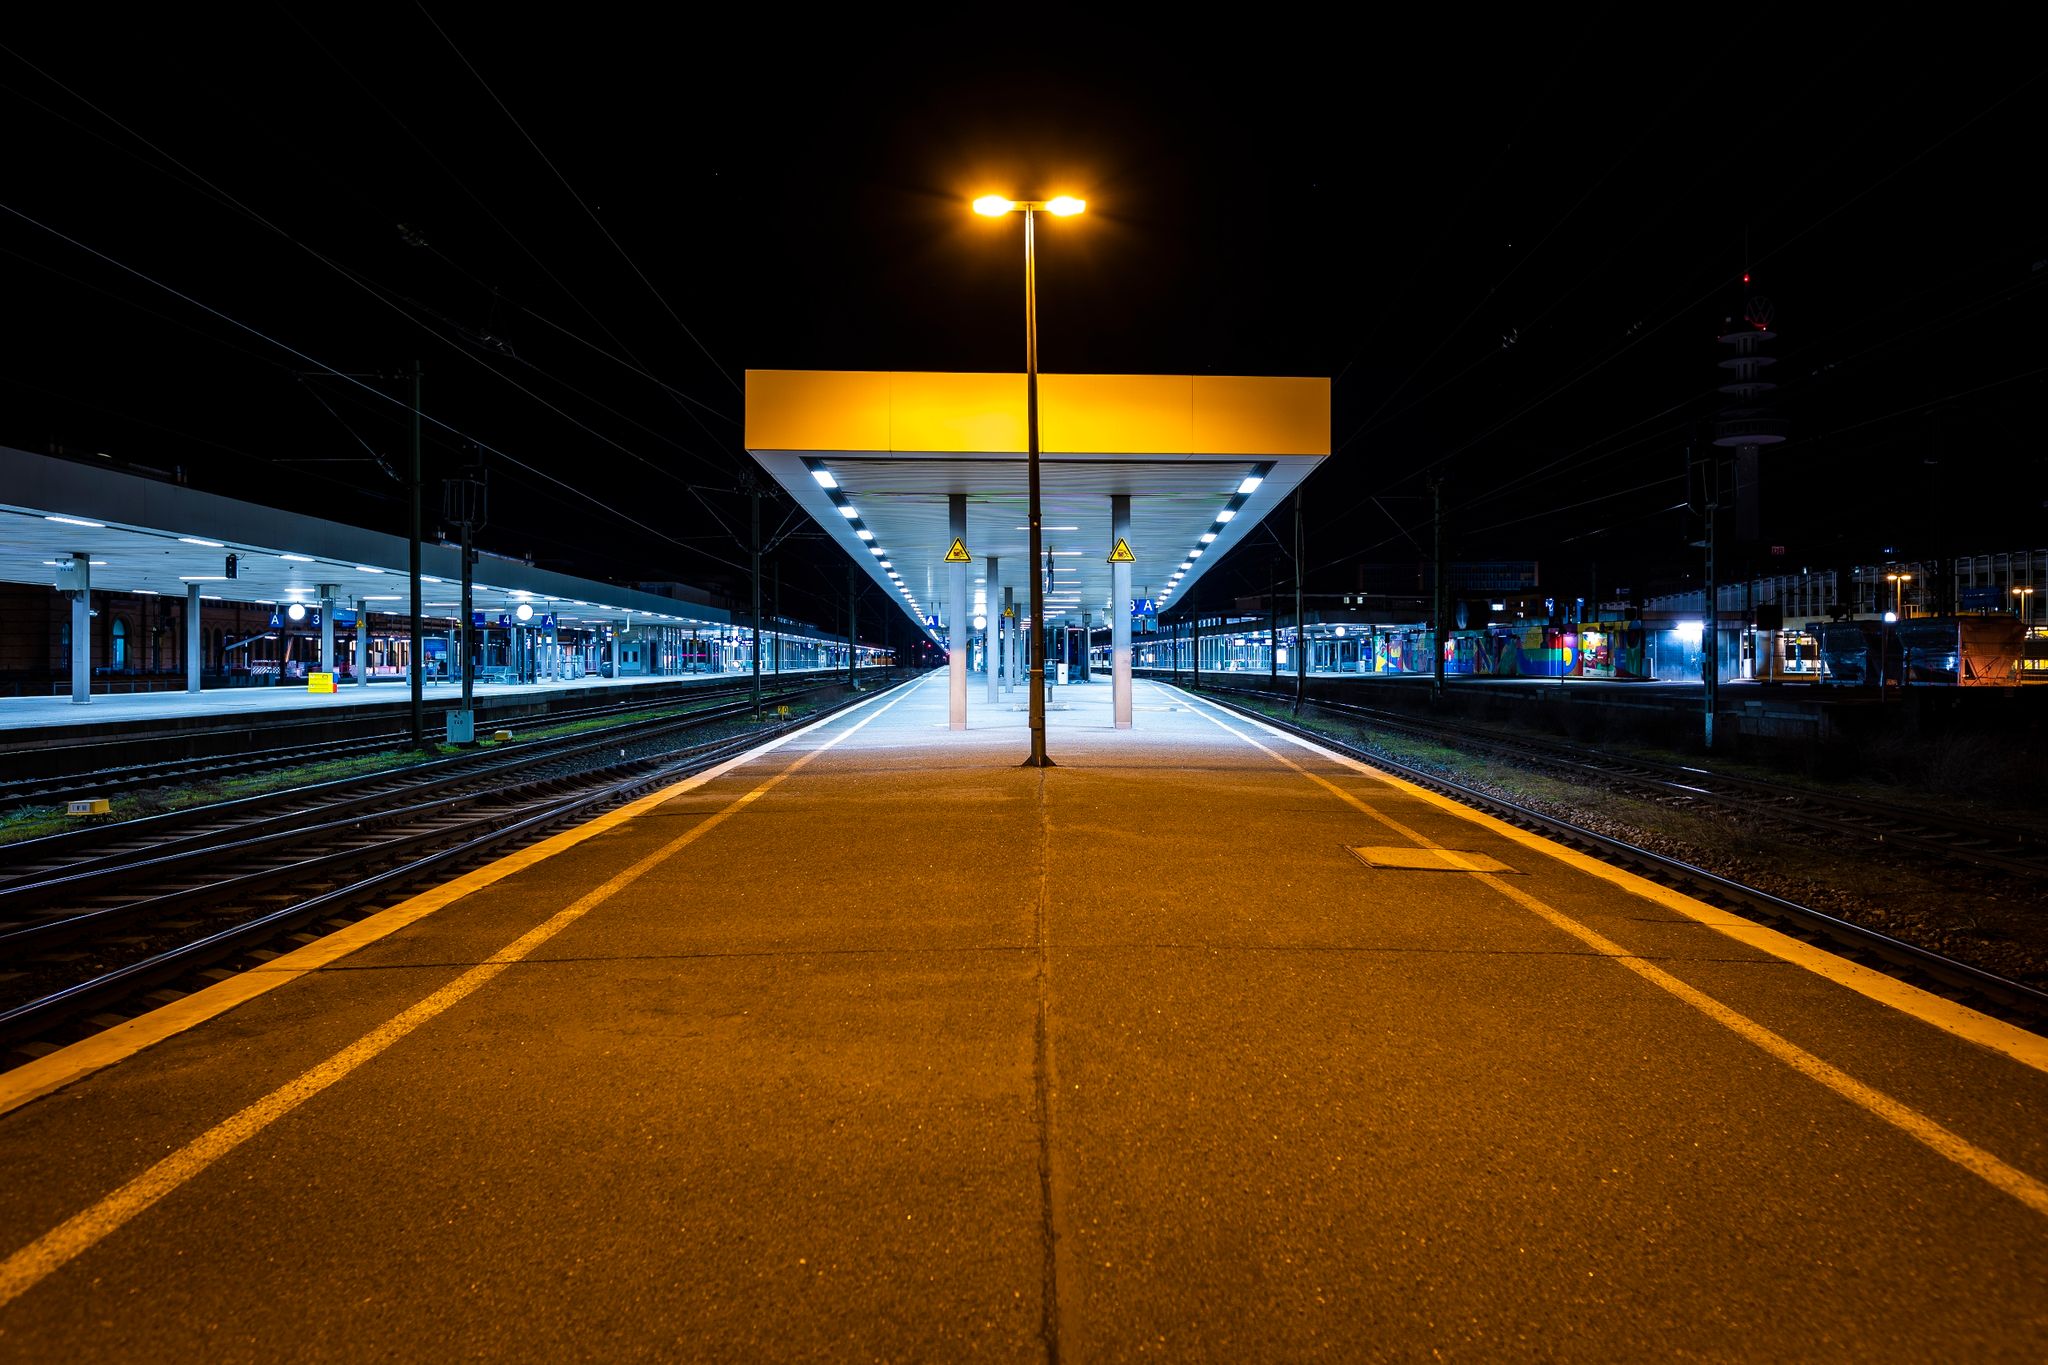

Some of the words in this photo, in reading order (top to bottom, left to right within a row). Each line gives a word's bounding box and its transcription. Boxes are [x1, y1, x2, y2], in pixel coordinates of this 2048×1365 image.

[1143, 600, 1153, 611] A
[271, 615, 279, 624] A
[313, 614, 320, 624] 3
[503, 615, 510, 624] 4
[546, 616, 554, 625] A
[926, 615, 935, 625] A
